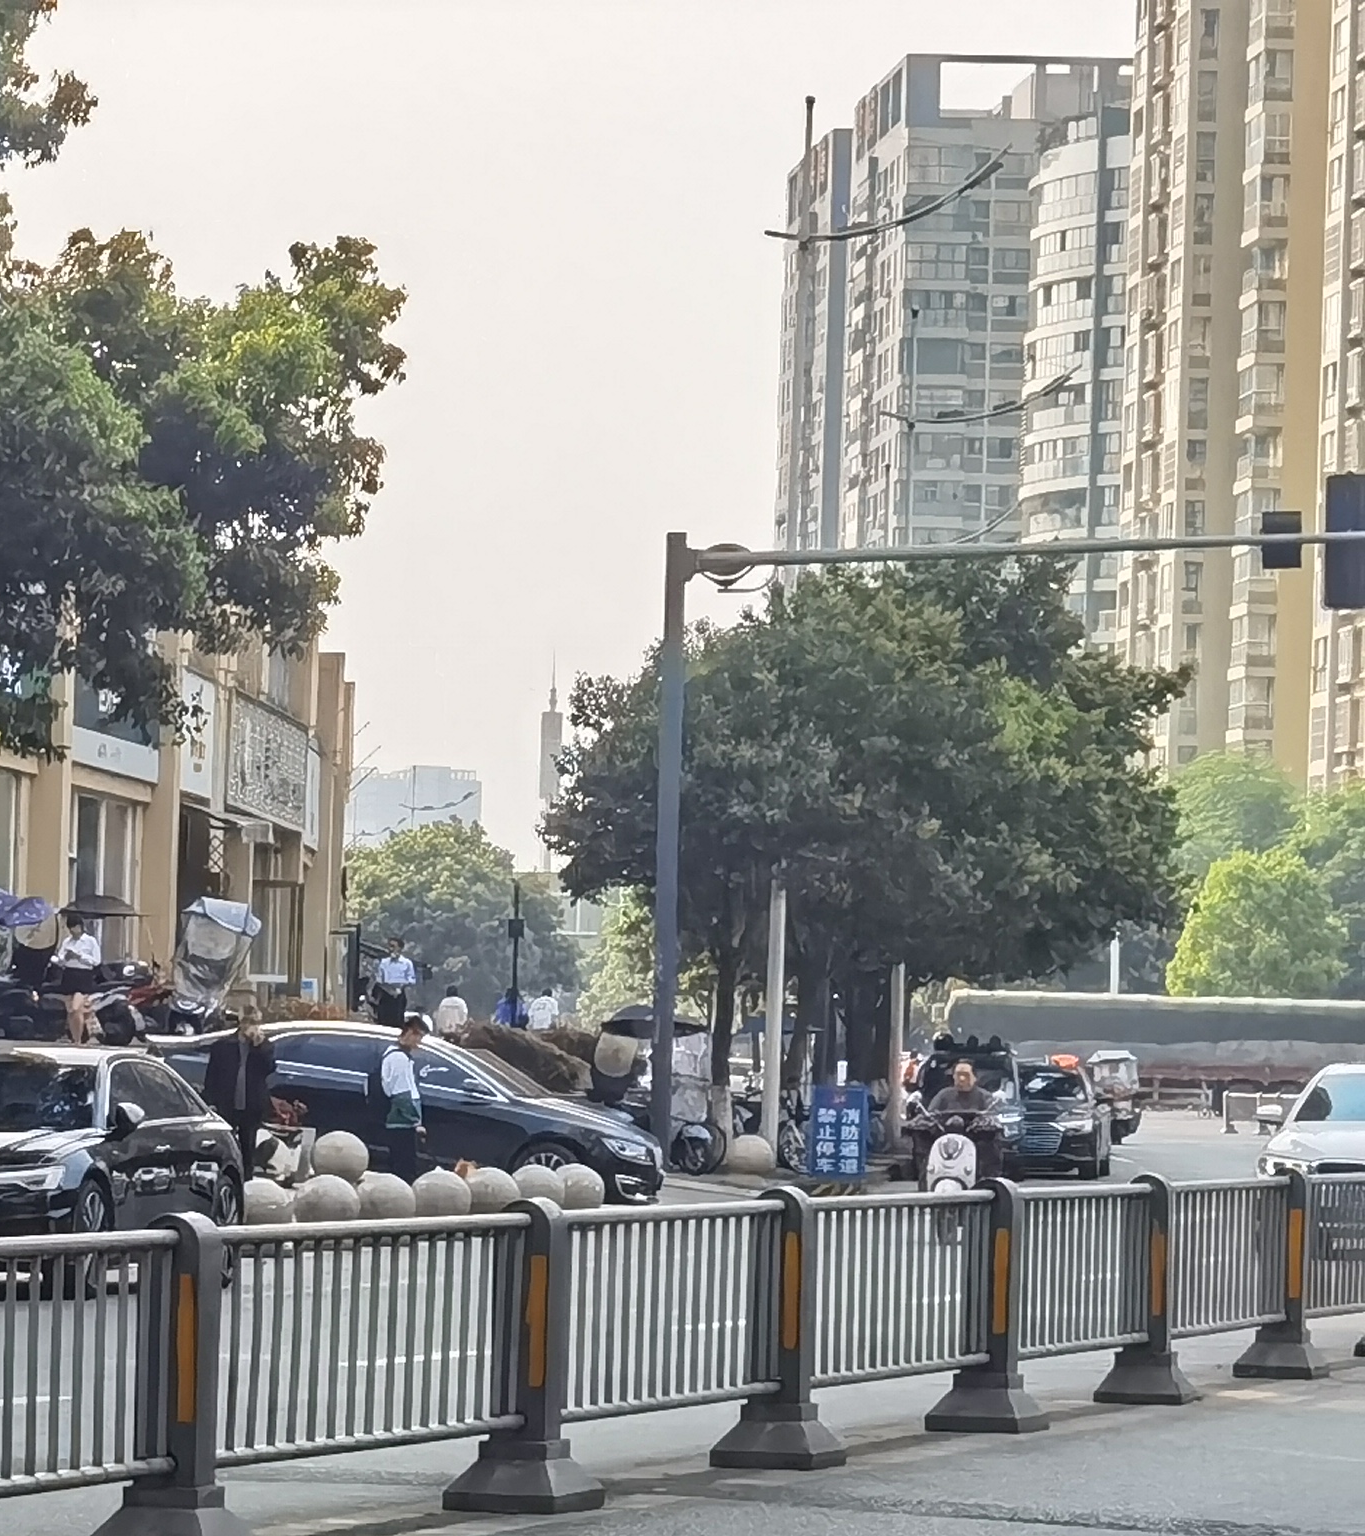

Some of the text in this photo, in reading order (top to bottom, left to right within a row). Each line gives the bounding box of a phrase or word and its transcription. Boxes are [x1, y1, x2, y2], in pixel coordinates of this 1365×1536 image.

[815, 1107, 838, 1174] 禁止停车
[838, 1107, 861, 1174] 消防通道
